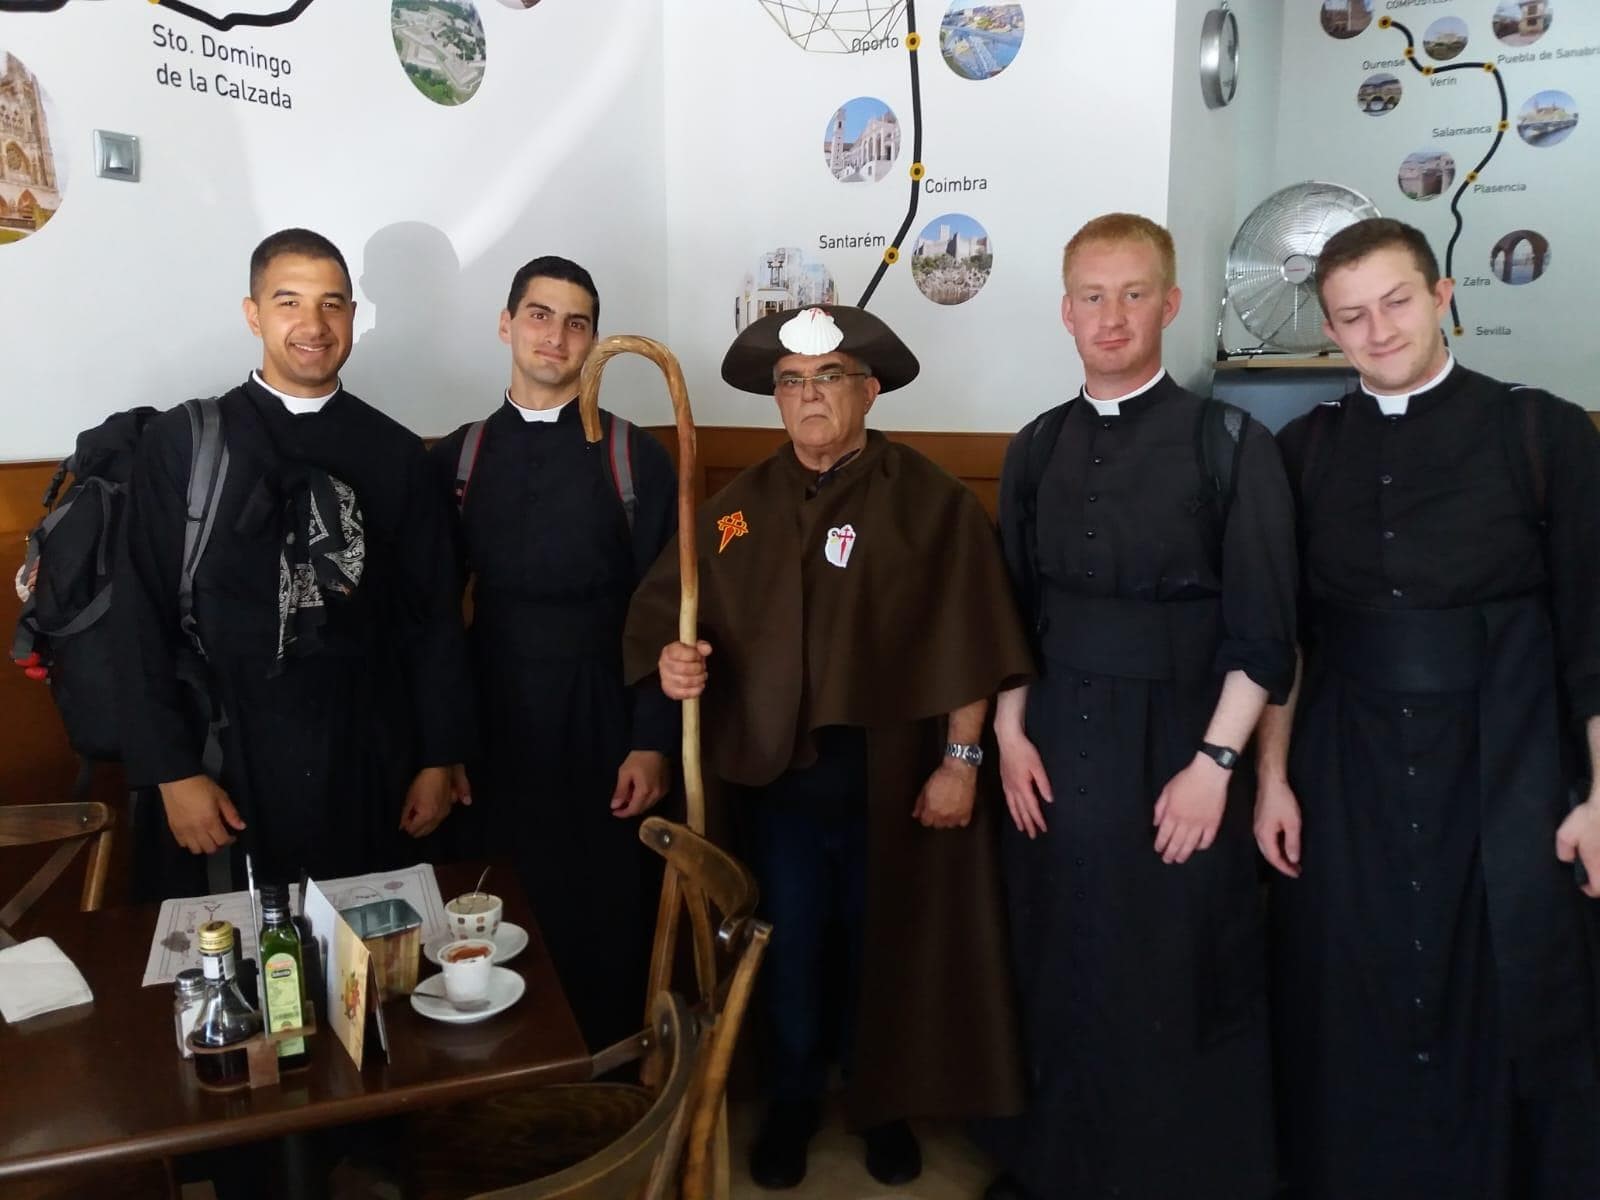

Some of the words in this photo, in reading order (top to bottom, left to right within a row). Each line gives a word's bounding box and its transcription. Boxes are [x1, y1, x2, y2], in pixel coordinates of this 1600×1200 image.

[152, 24, 194, 54] Sto.
[201, 34, 292, 78] Domingo
[852, 37, 899, 56] Oporto
[1497, 52, 1535, 64] Puebla
[1539, 50, 1553, 61] de
[1362, 59, 1406, 70] Ourense
[156, 63, 182, 88] de
[189, 68, 208, 92] la
[215, 74, 292, 109] Calzada
[1432, 125, 1492, 138] Salamanca
[925, 176, 988, 194] Coimbra
[1474, 183, 1527, 193] Plasencia
[819, 233, 886, 249] Santarém
[1463, 276, 1491, 287] Zafra
[1475, 326, 1512, 336] Sevilla
